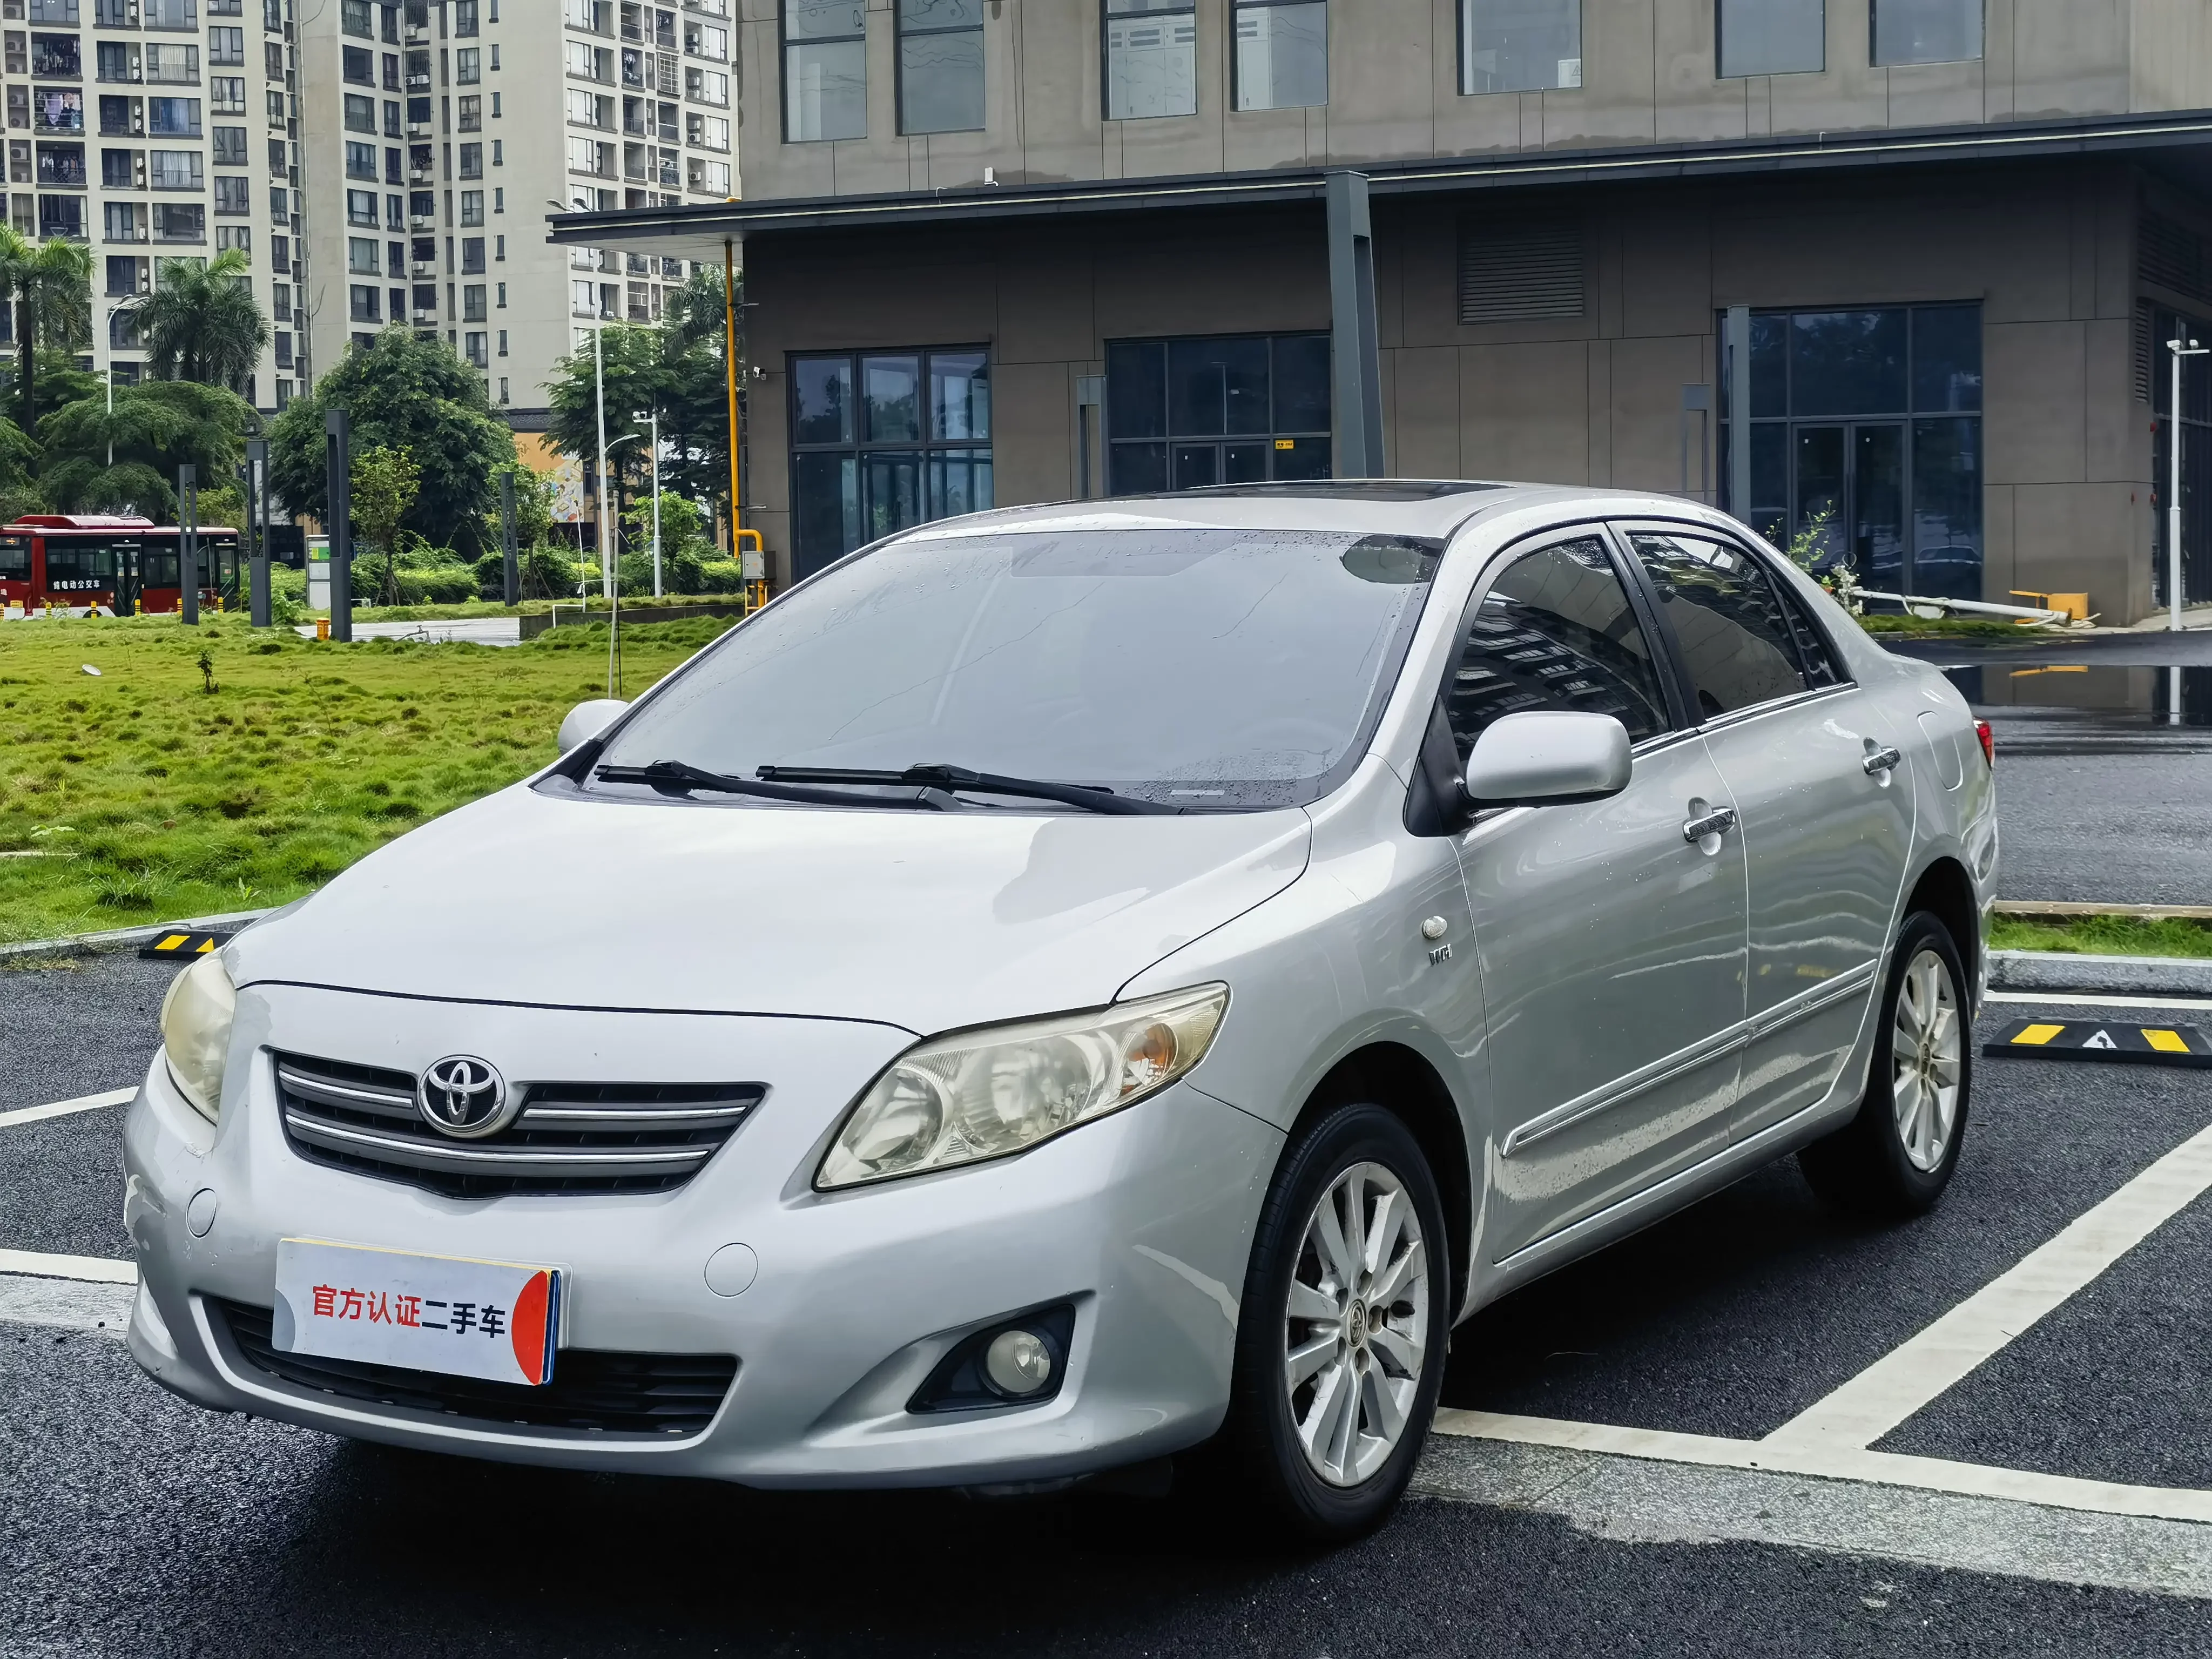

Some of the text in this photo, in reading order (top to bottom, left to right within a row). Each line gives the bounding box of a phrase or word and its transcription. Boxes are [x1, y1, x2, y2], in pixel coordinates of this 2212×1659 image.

[313, 1284, 505, 1339] 官方认证二手车
